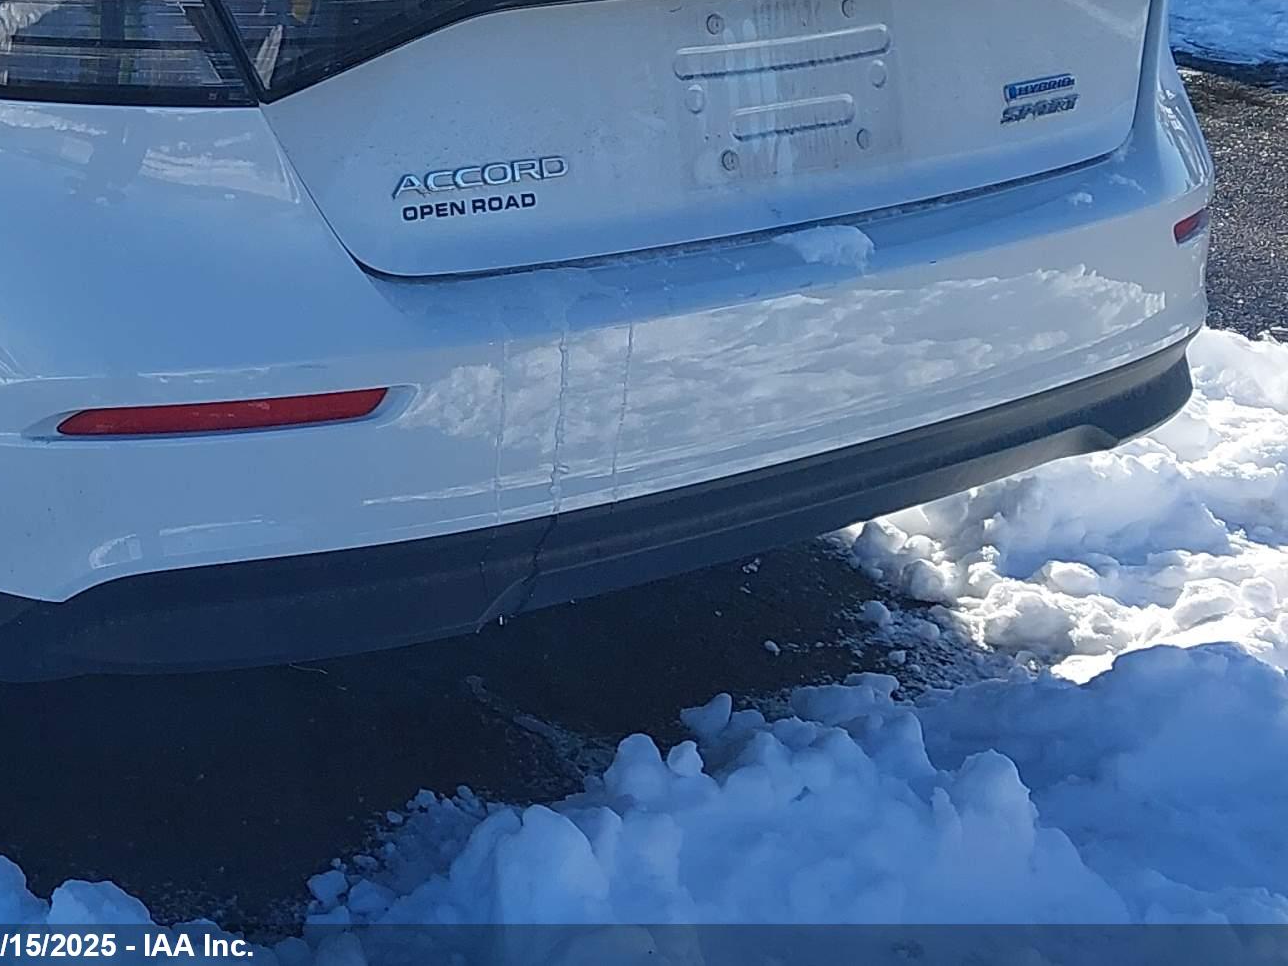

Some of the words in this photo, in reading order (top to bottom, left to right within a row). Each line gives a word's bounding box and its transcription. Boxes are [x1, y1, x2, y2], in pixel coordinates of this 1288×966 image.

[1016, 76, 1075, 96] HYBRID
[1000, 94, 1079, 125] SPORT
[392, 156, 569, 200] ACCORD
[402, 200, 466, 221] OPEN
[471, 193, 536, 214] ROAD
